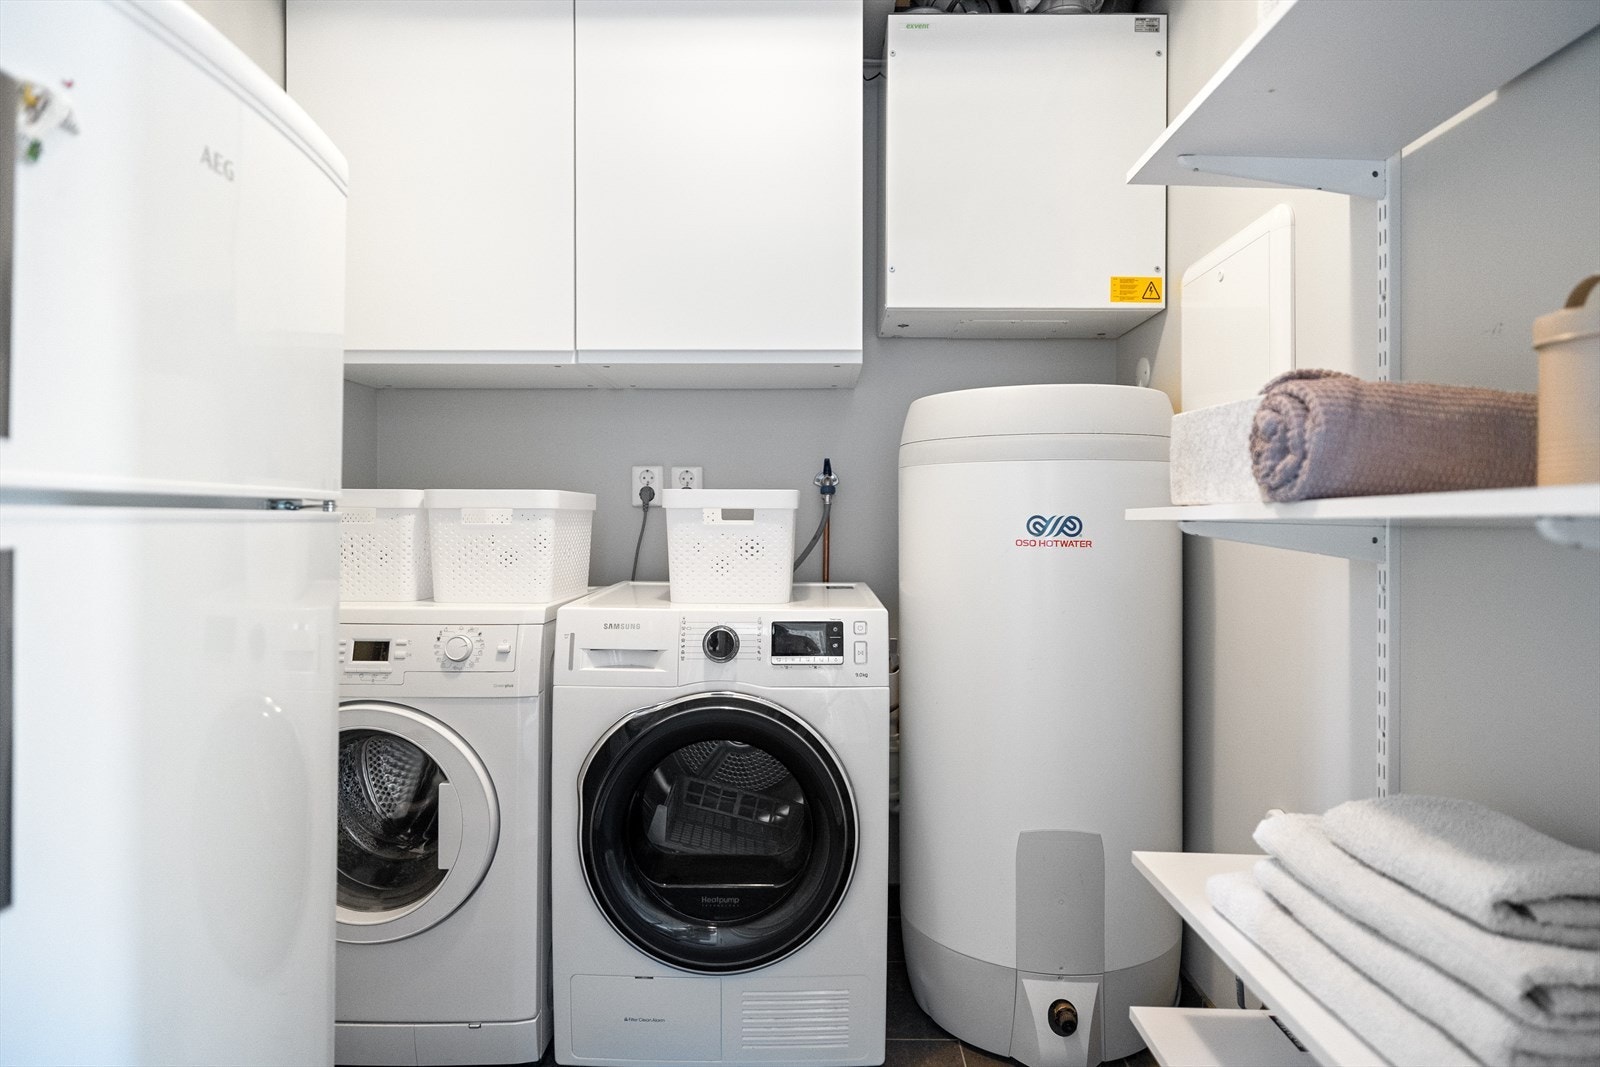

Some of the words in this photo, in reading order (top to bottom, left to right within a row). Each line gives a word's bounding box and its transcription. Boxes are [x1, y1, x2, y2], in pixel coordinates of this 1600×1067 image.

[200, 144, 235, 182] AEG
[1015, 539, 1037, 547] OSO
[1038, 539, 1093, 548] HOTWATER
[603, 622, 641, 630] SAMSUNG
[701, 896, 740, 904] Heatpump
